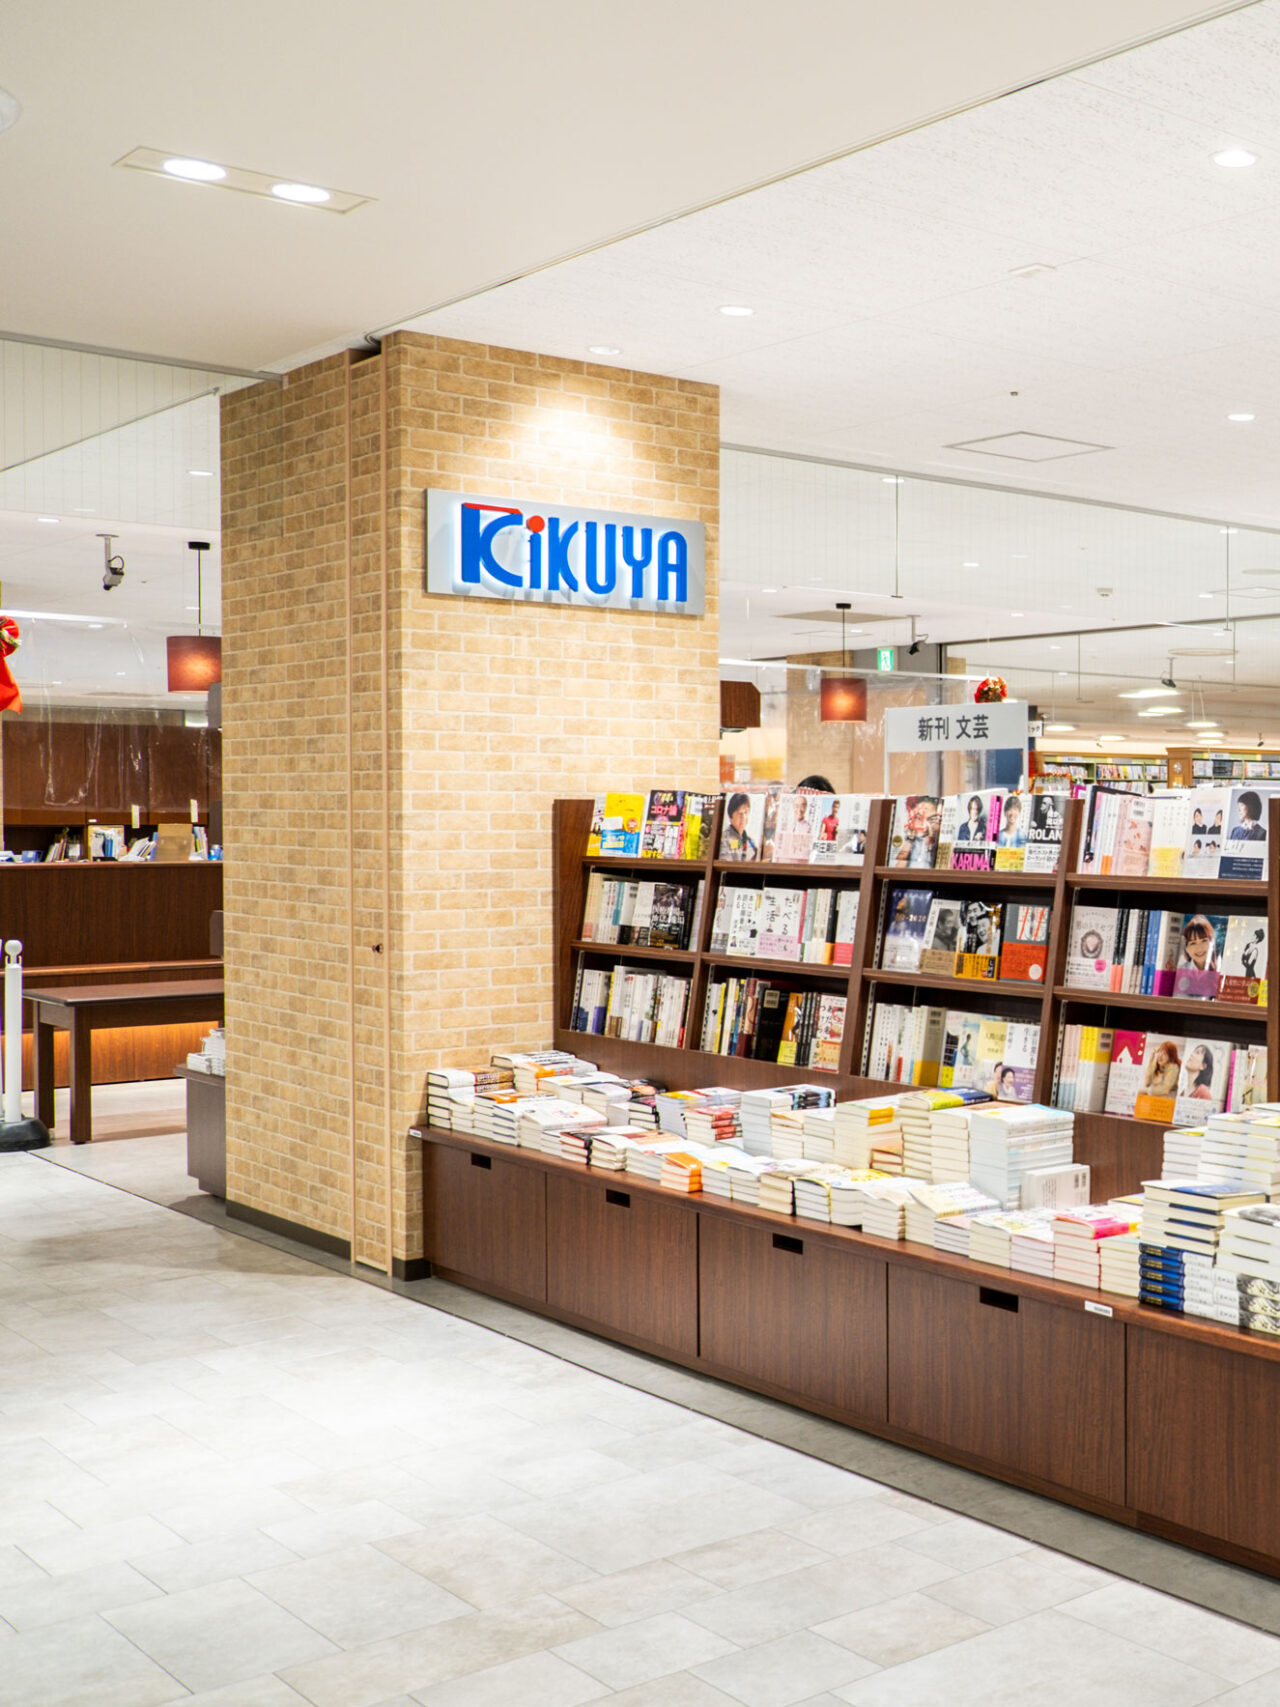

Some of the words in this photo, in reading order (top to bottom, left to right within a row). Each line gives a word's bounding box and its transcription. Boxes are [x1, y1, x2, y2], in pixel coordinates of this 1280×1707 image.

[918, 716, 949, 741] 新刊
[955, 714, 989, 739] 文芸
[1028, 828, 1062, 841] ROLAN
[782, 897, 793, 935] たべる
